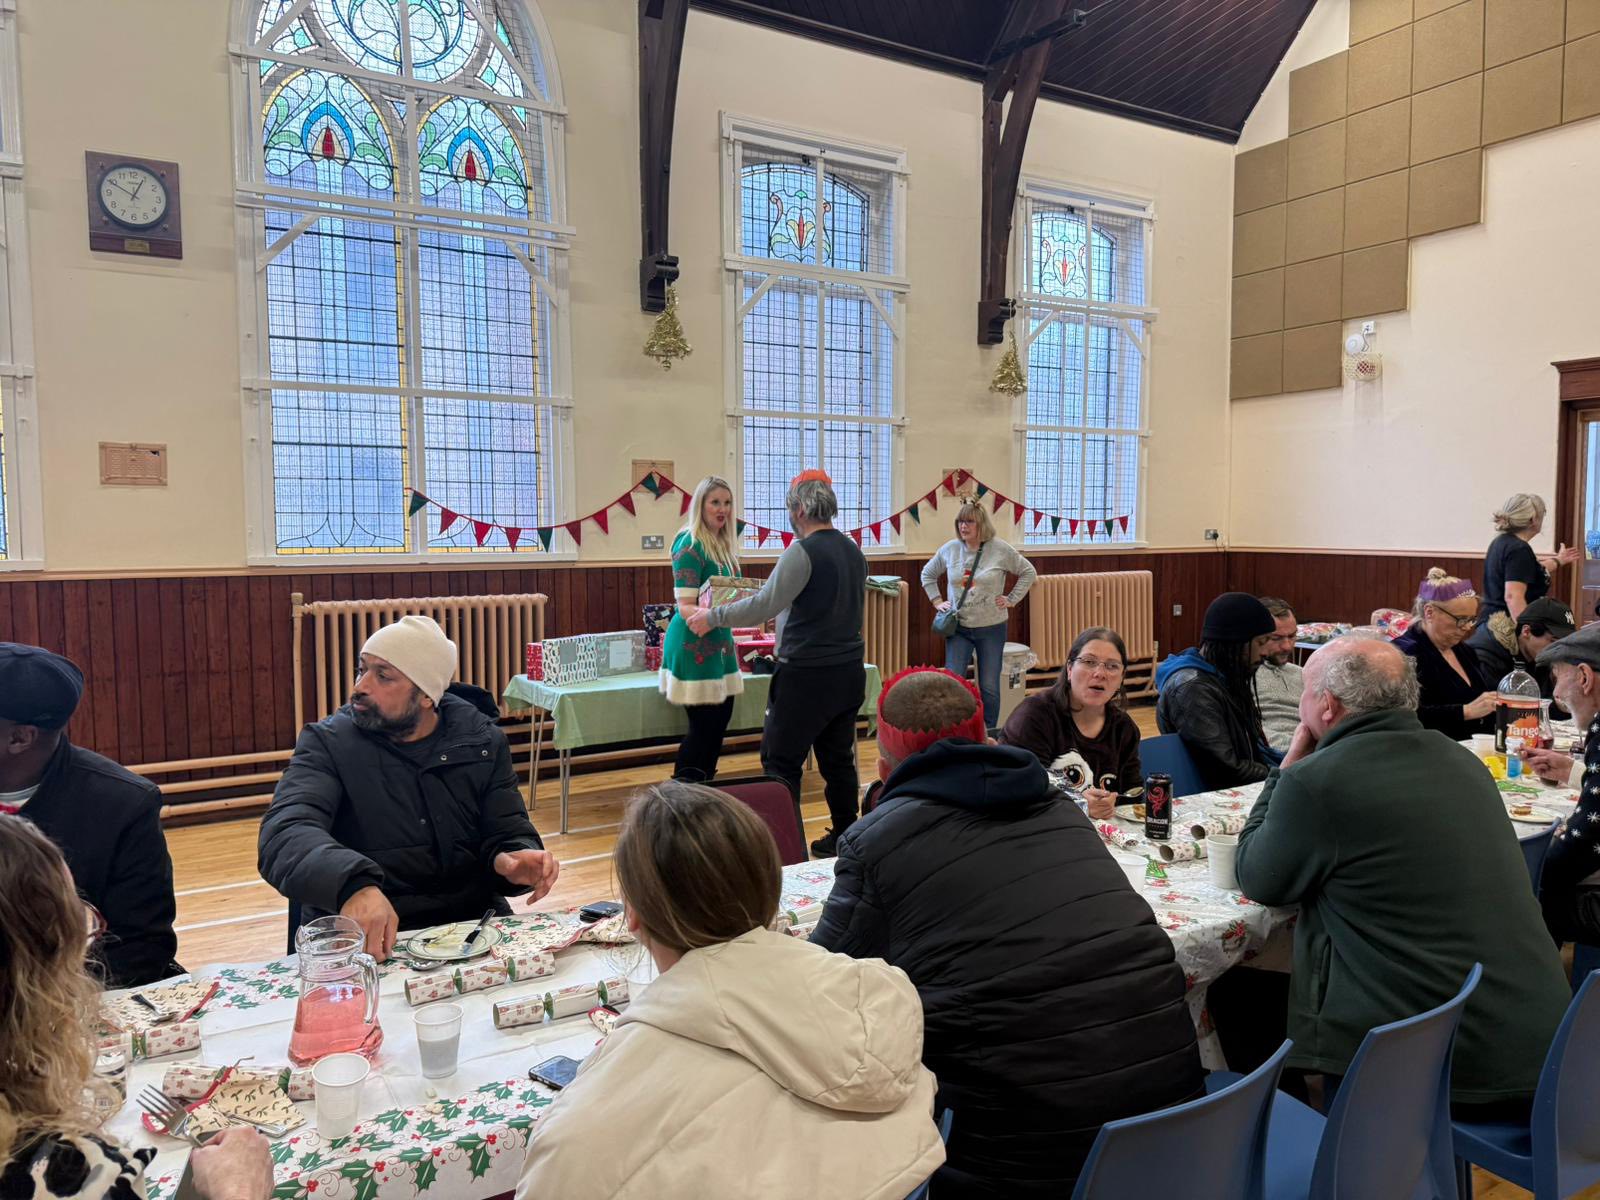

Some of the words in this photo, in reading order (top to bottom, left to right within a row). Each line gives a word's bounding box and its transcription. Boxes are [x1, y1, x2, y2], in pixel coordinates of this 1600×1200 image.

[129, 171, 138, 179] 12
[106, 189, 112, 197] 9
[155, 196, 161, 204] 3
[111, 201, 117, 209] 8
[131, 213, 137, 221] 6
[143, 212, 149, 220] 5
[1506, 723, 1539, 738] Tango
